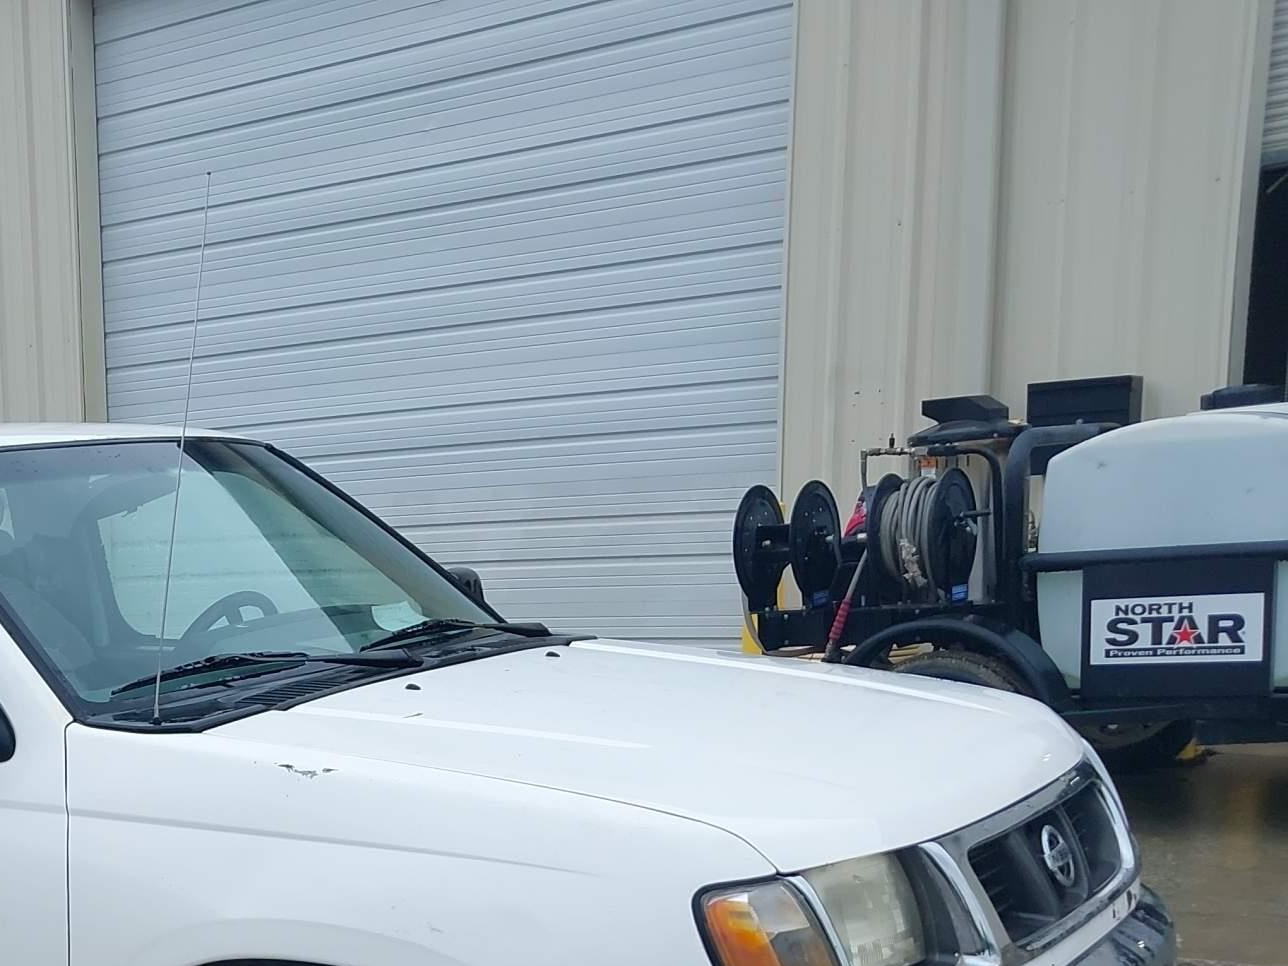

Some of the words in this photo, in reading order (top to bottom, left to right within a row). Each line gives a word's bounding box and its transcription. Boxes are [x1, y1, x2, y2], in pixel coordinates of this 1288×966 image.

[1115, 601, 1194, 616] NORTH
[1104, 613, 1246, 647] STAR
[1109, 648, 1153, 657] Proven
[1156, 646, 1242, 656] Performance
